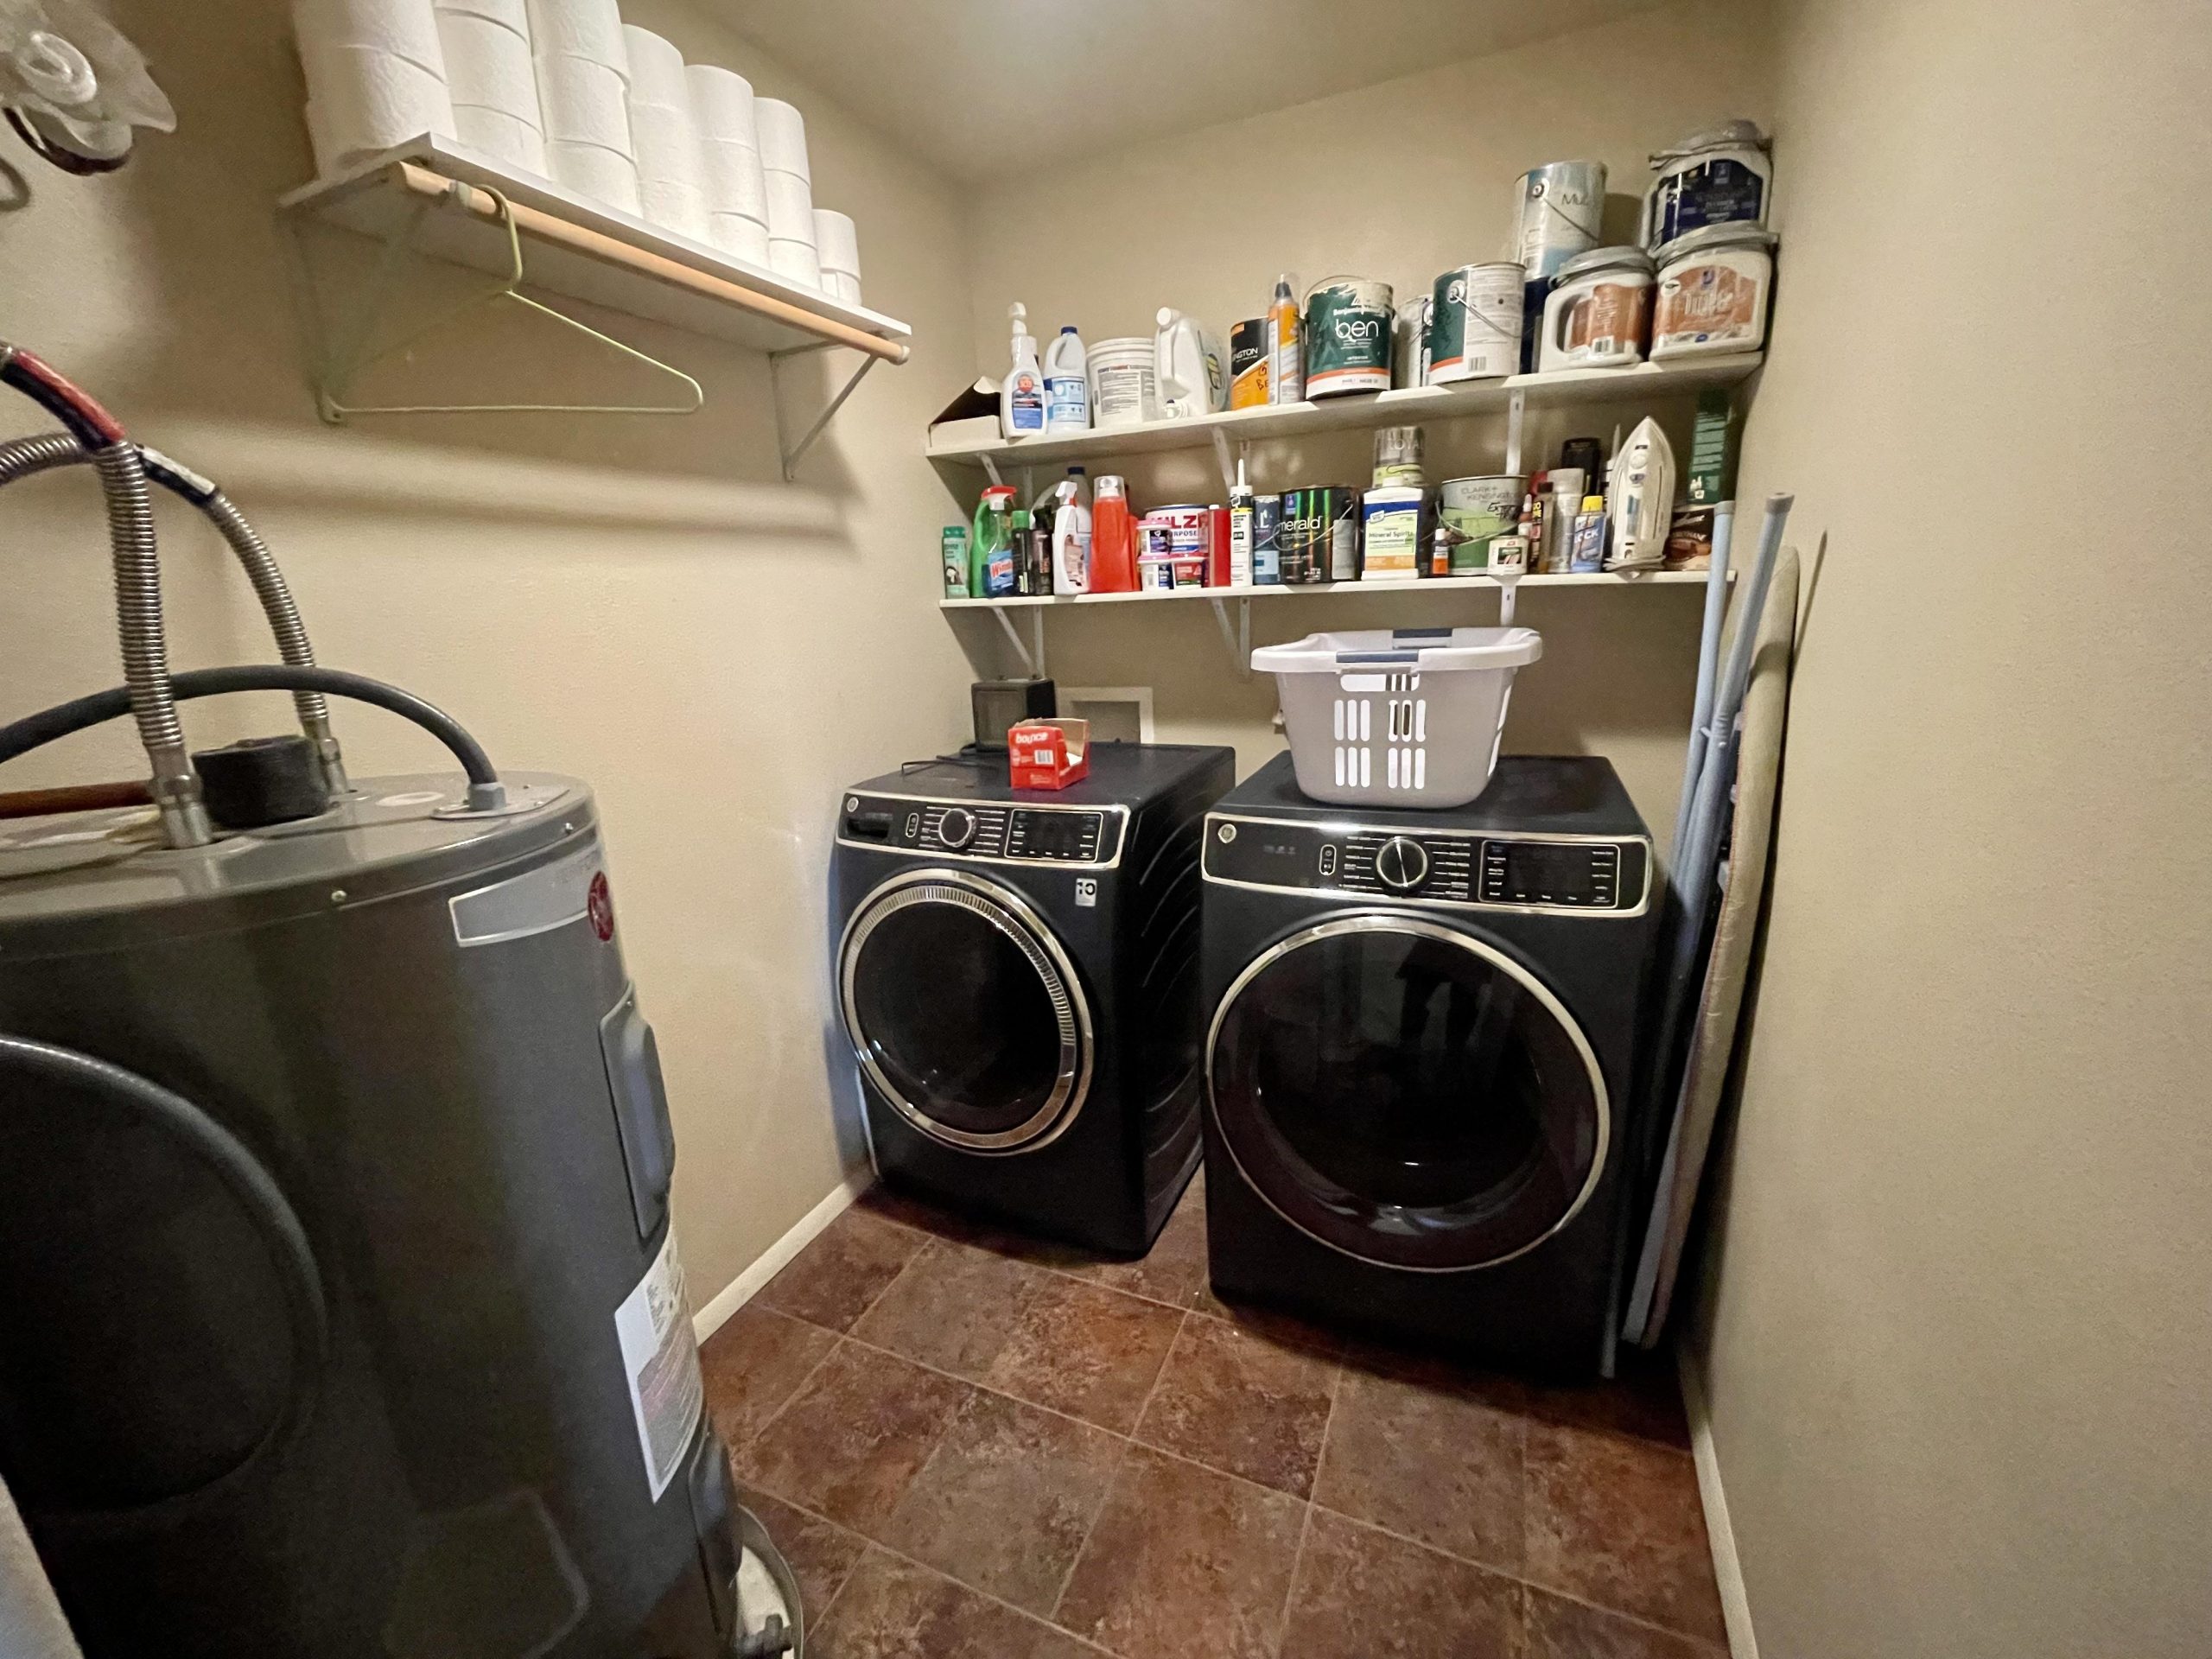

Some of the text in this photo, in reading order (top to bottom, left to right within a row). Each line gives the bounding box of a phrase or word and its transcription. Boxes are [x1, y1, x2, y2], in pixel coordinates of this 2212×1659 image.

[1335, 318, 1379, 339] ben
[1015, 732, 1049, 745] bounce
[1076, 881, 1096, 896] 10
